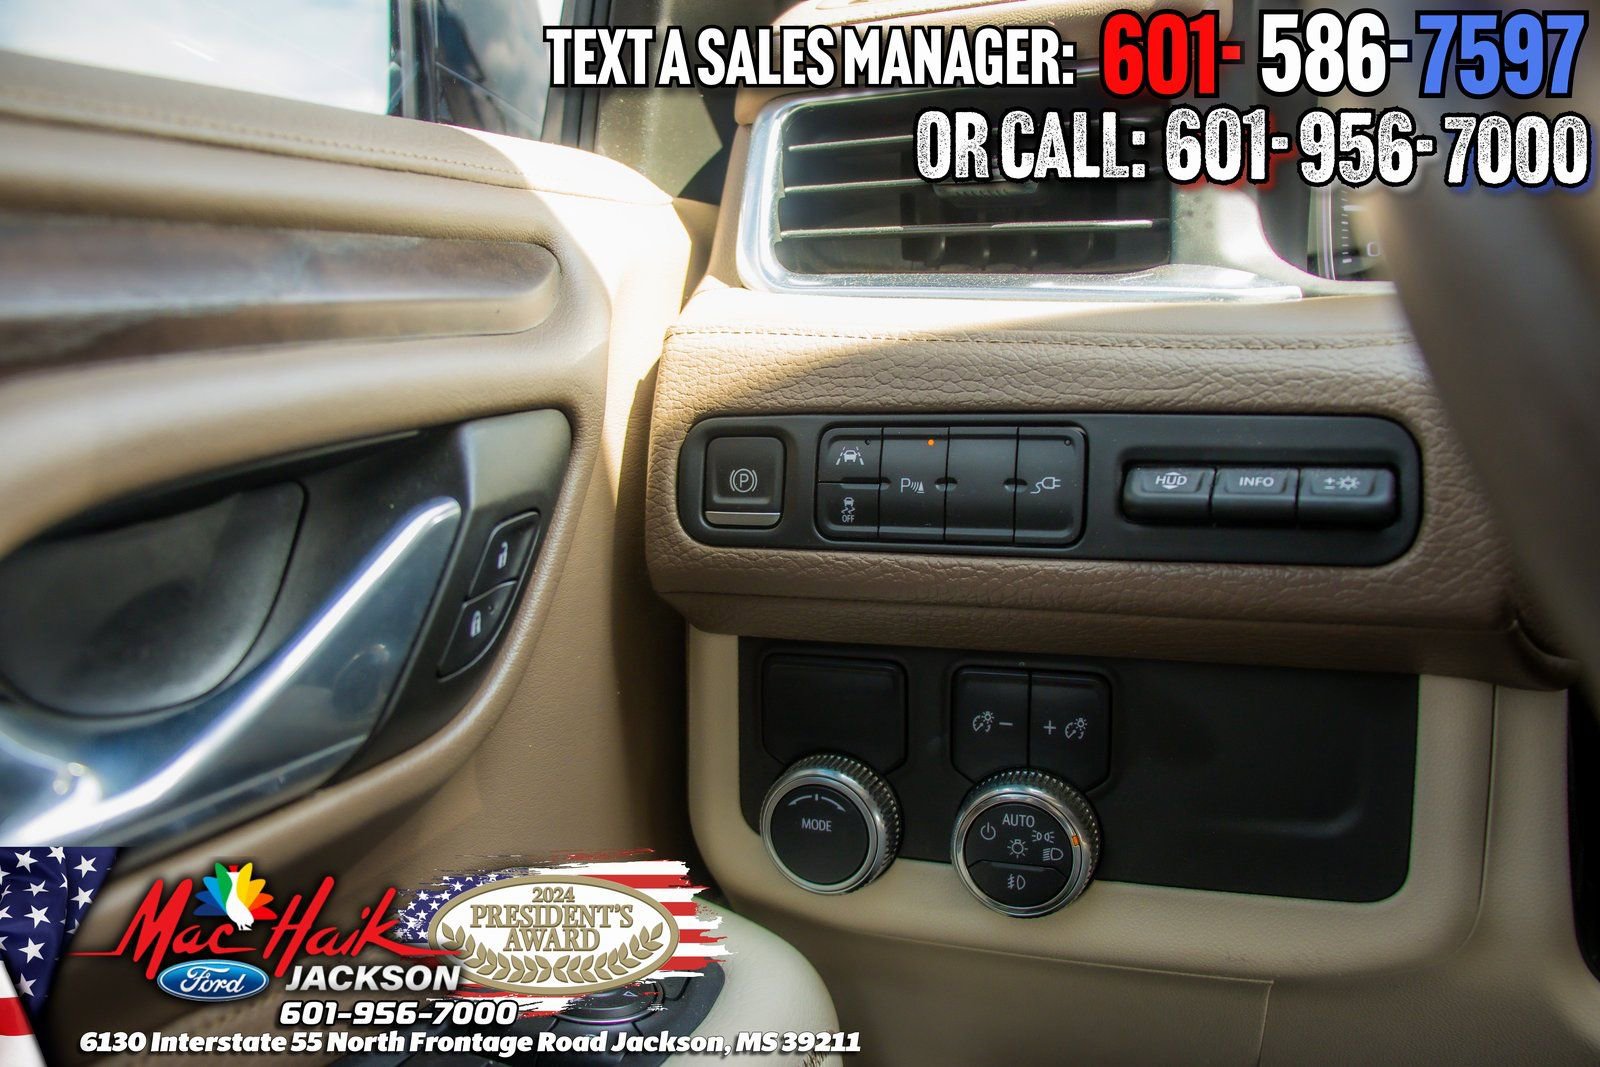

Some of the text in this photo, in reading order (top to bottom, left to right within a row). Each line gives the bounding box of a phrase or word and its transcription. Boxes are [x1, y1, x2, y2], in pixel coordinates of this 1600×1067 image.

[1155, 475, 1187, 486] HUD
[1239, 477, 1274, 487] INFO
[842, 514, 855, 524] OFF
[801, 817, 832, 832] MODE
[1002, 814, 1035, 829] AUTO
